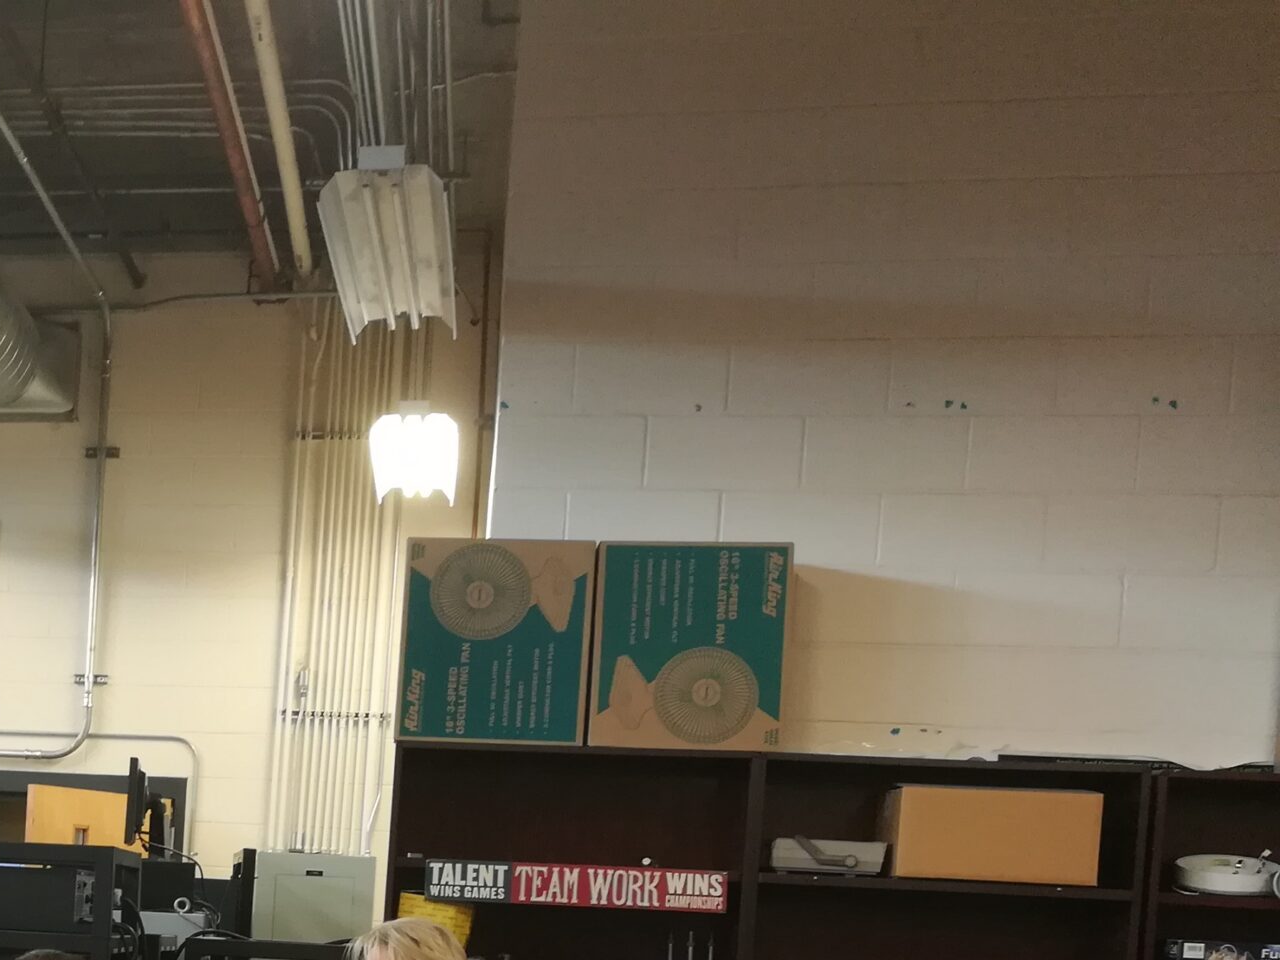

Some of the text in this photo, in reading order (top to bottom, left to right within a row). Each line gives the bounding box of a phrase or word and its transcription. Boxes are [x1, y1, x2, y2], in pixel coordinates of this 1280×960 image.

[715, 550, 729, 645] OSCILLATING FAN
[446, 667, 459, 713] 3-SPEED
[455, 642, 472, 735] OSCILLATING FAN
[429, 861, 509, 888] TALENT
[514, 866, 660, 908] TEAM WORK
[666, 872, 723, 897] WINS
[430, 884, 505, 900] WINS GAMES
[665, 894, 723, 910] CHAMPIONSHIPS
